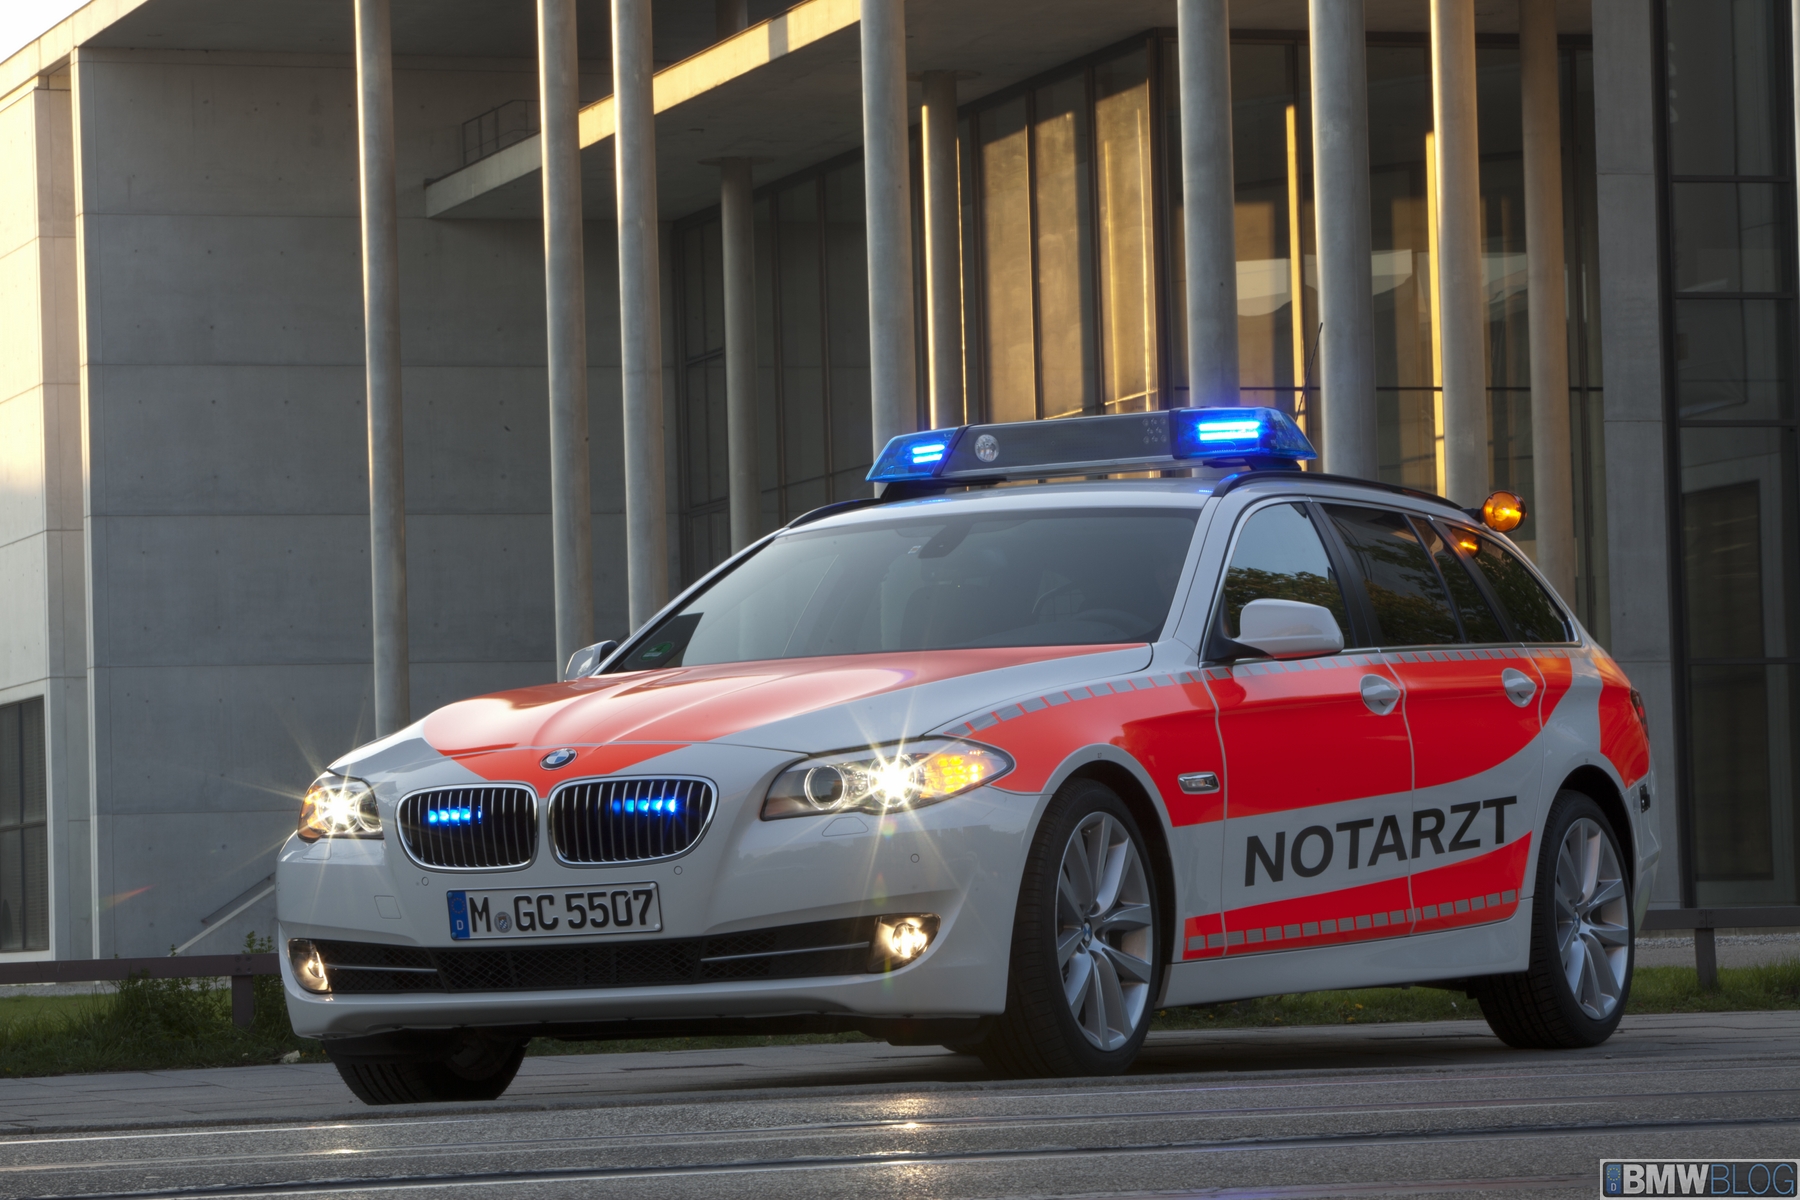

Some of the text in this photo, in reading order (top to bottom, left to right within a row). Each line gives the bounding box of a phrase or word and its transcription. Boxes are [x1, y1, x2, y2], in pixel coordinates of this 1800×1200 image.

[1244, 795, 1518, 888] NOTARZT
[456, 889, 653, 933] D M GC 5507
